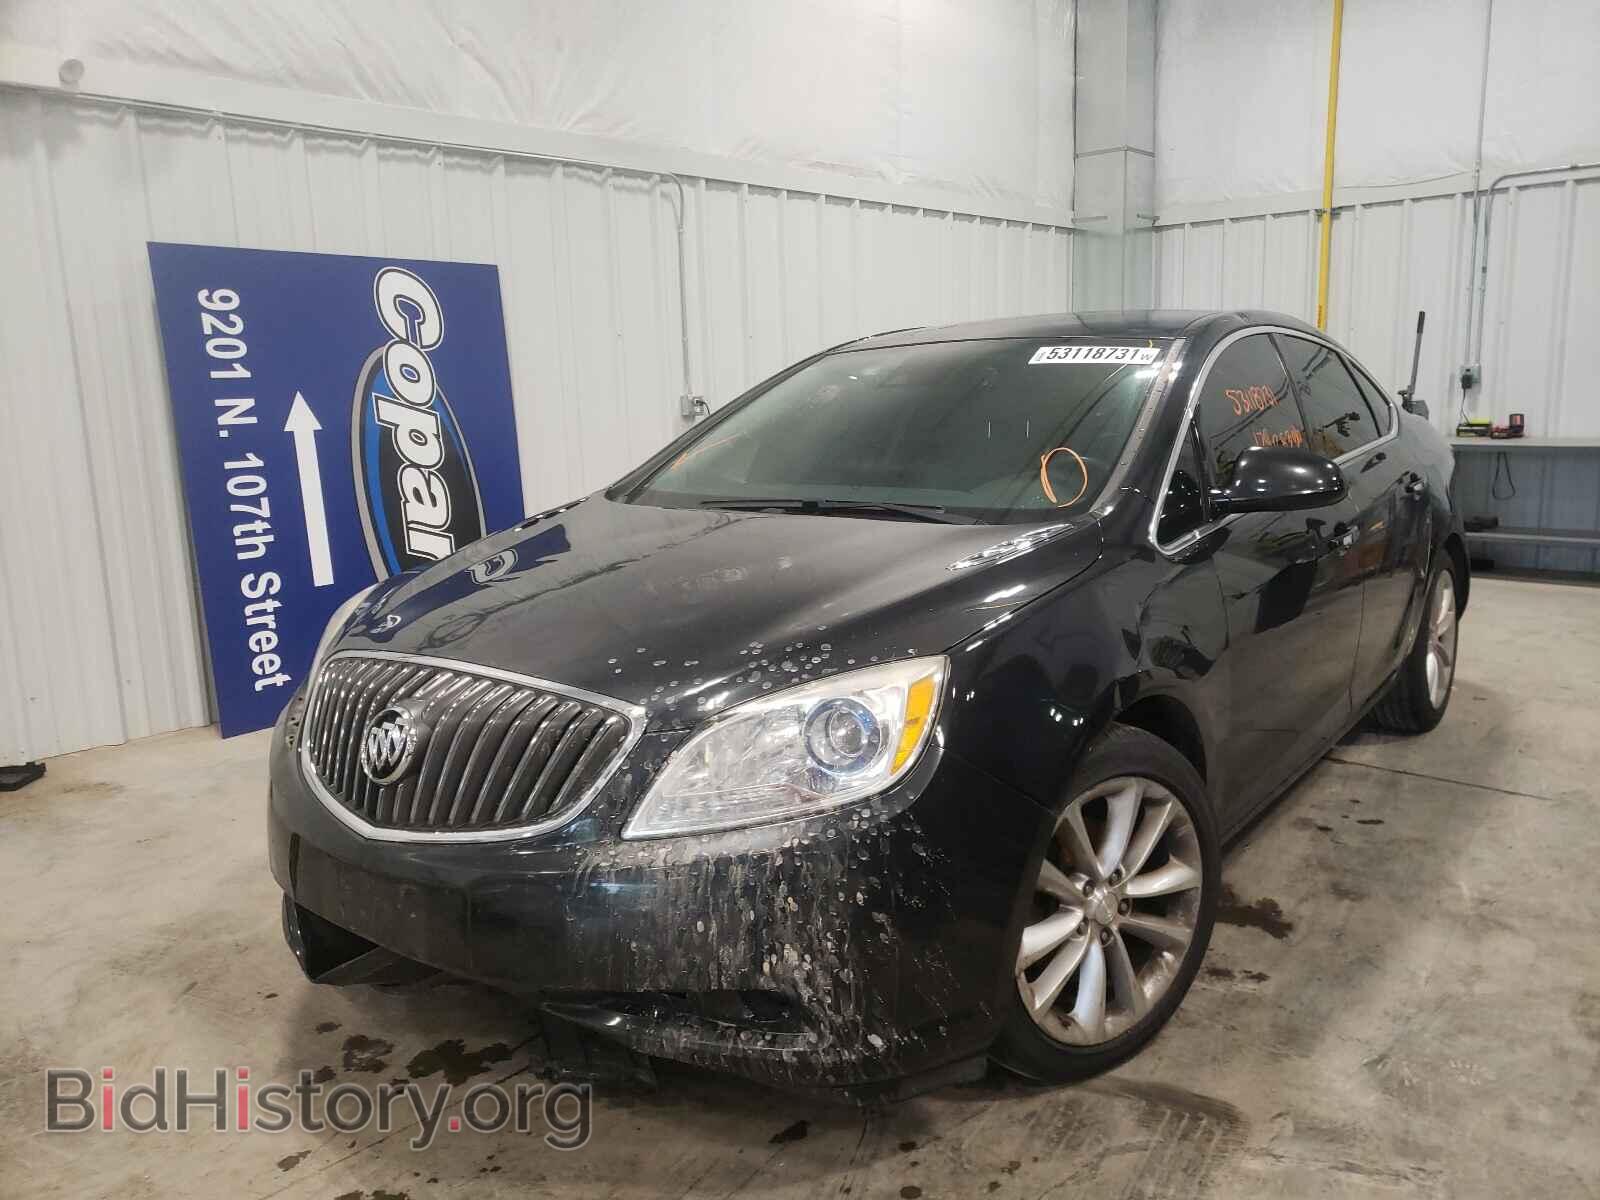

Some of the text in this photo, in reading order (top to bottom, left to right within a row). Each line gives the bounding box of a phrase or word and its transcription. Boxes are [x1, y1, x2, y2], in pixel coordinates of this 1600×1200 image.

[1046, 347, 1141, 361] 53118731
[197, 288, 293, 692] 9201 N. 107th Street
